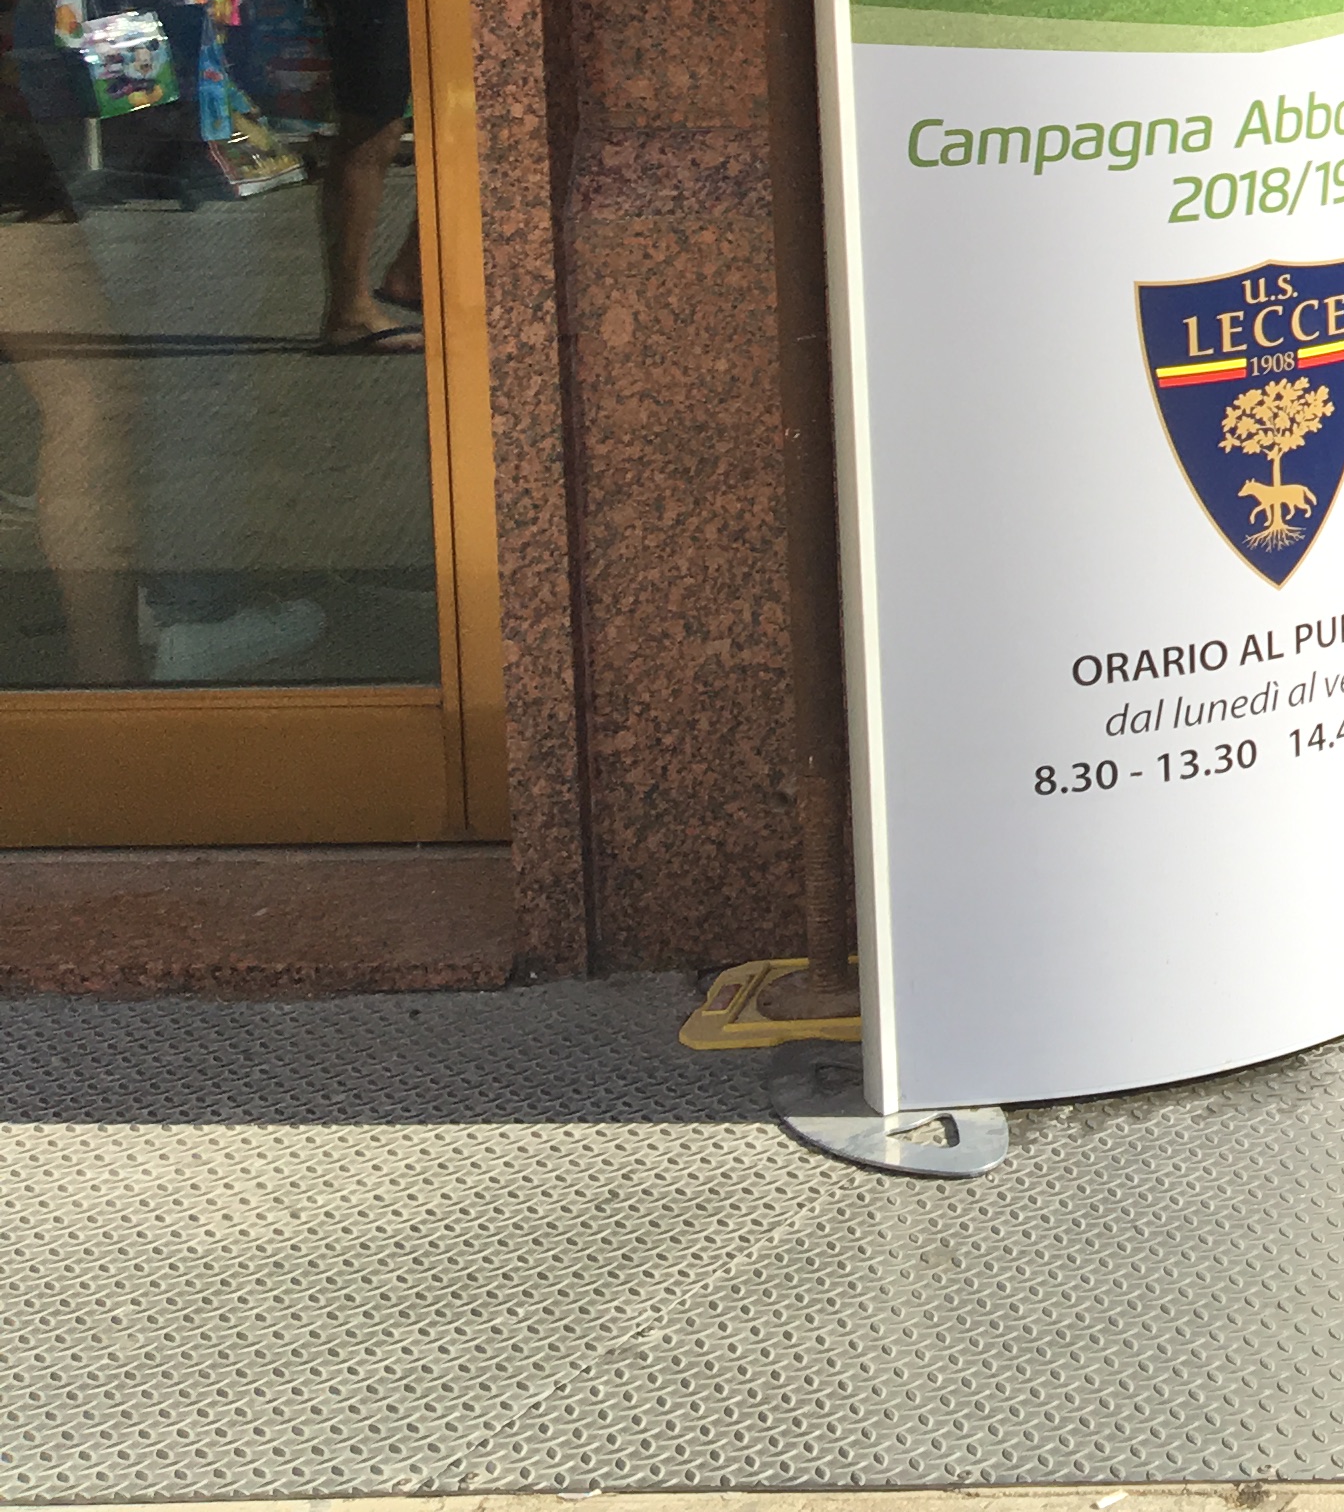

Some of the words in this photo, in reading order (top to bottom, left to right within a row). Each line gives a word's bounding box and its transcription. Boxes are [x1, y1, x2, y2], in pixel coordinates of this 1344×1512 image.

[906, 113, 1213, 176] Campagna
[1250, 351, 1296, 377] 1908
[1072, 639, 1228, 687] ORARIO
[1239, 630, 1285, 666] AL
[1105, 696, 1164, 737] dal
[1174, 680, 1280, 728] lunedì
[1287, 671, 1316, 708] al
[1033, 759, 1119, 797] 8.30
[1156, 738, 1258, 783] 13.30
